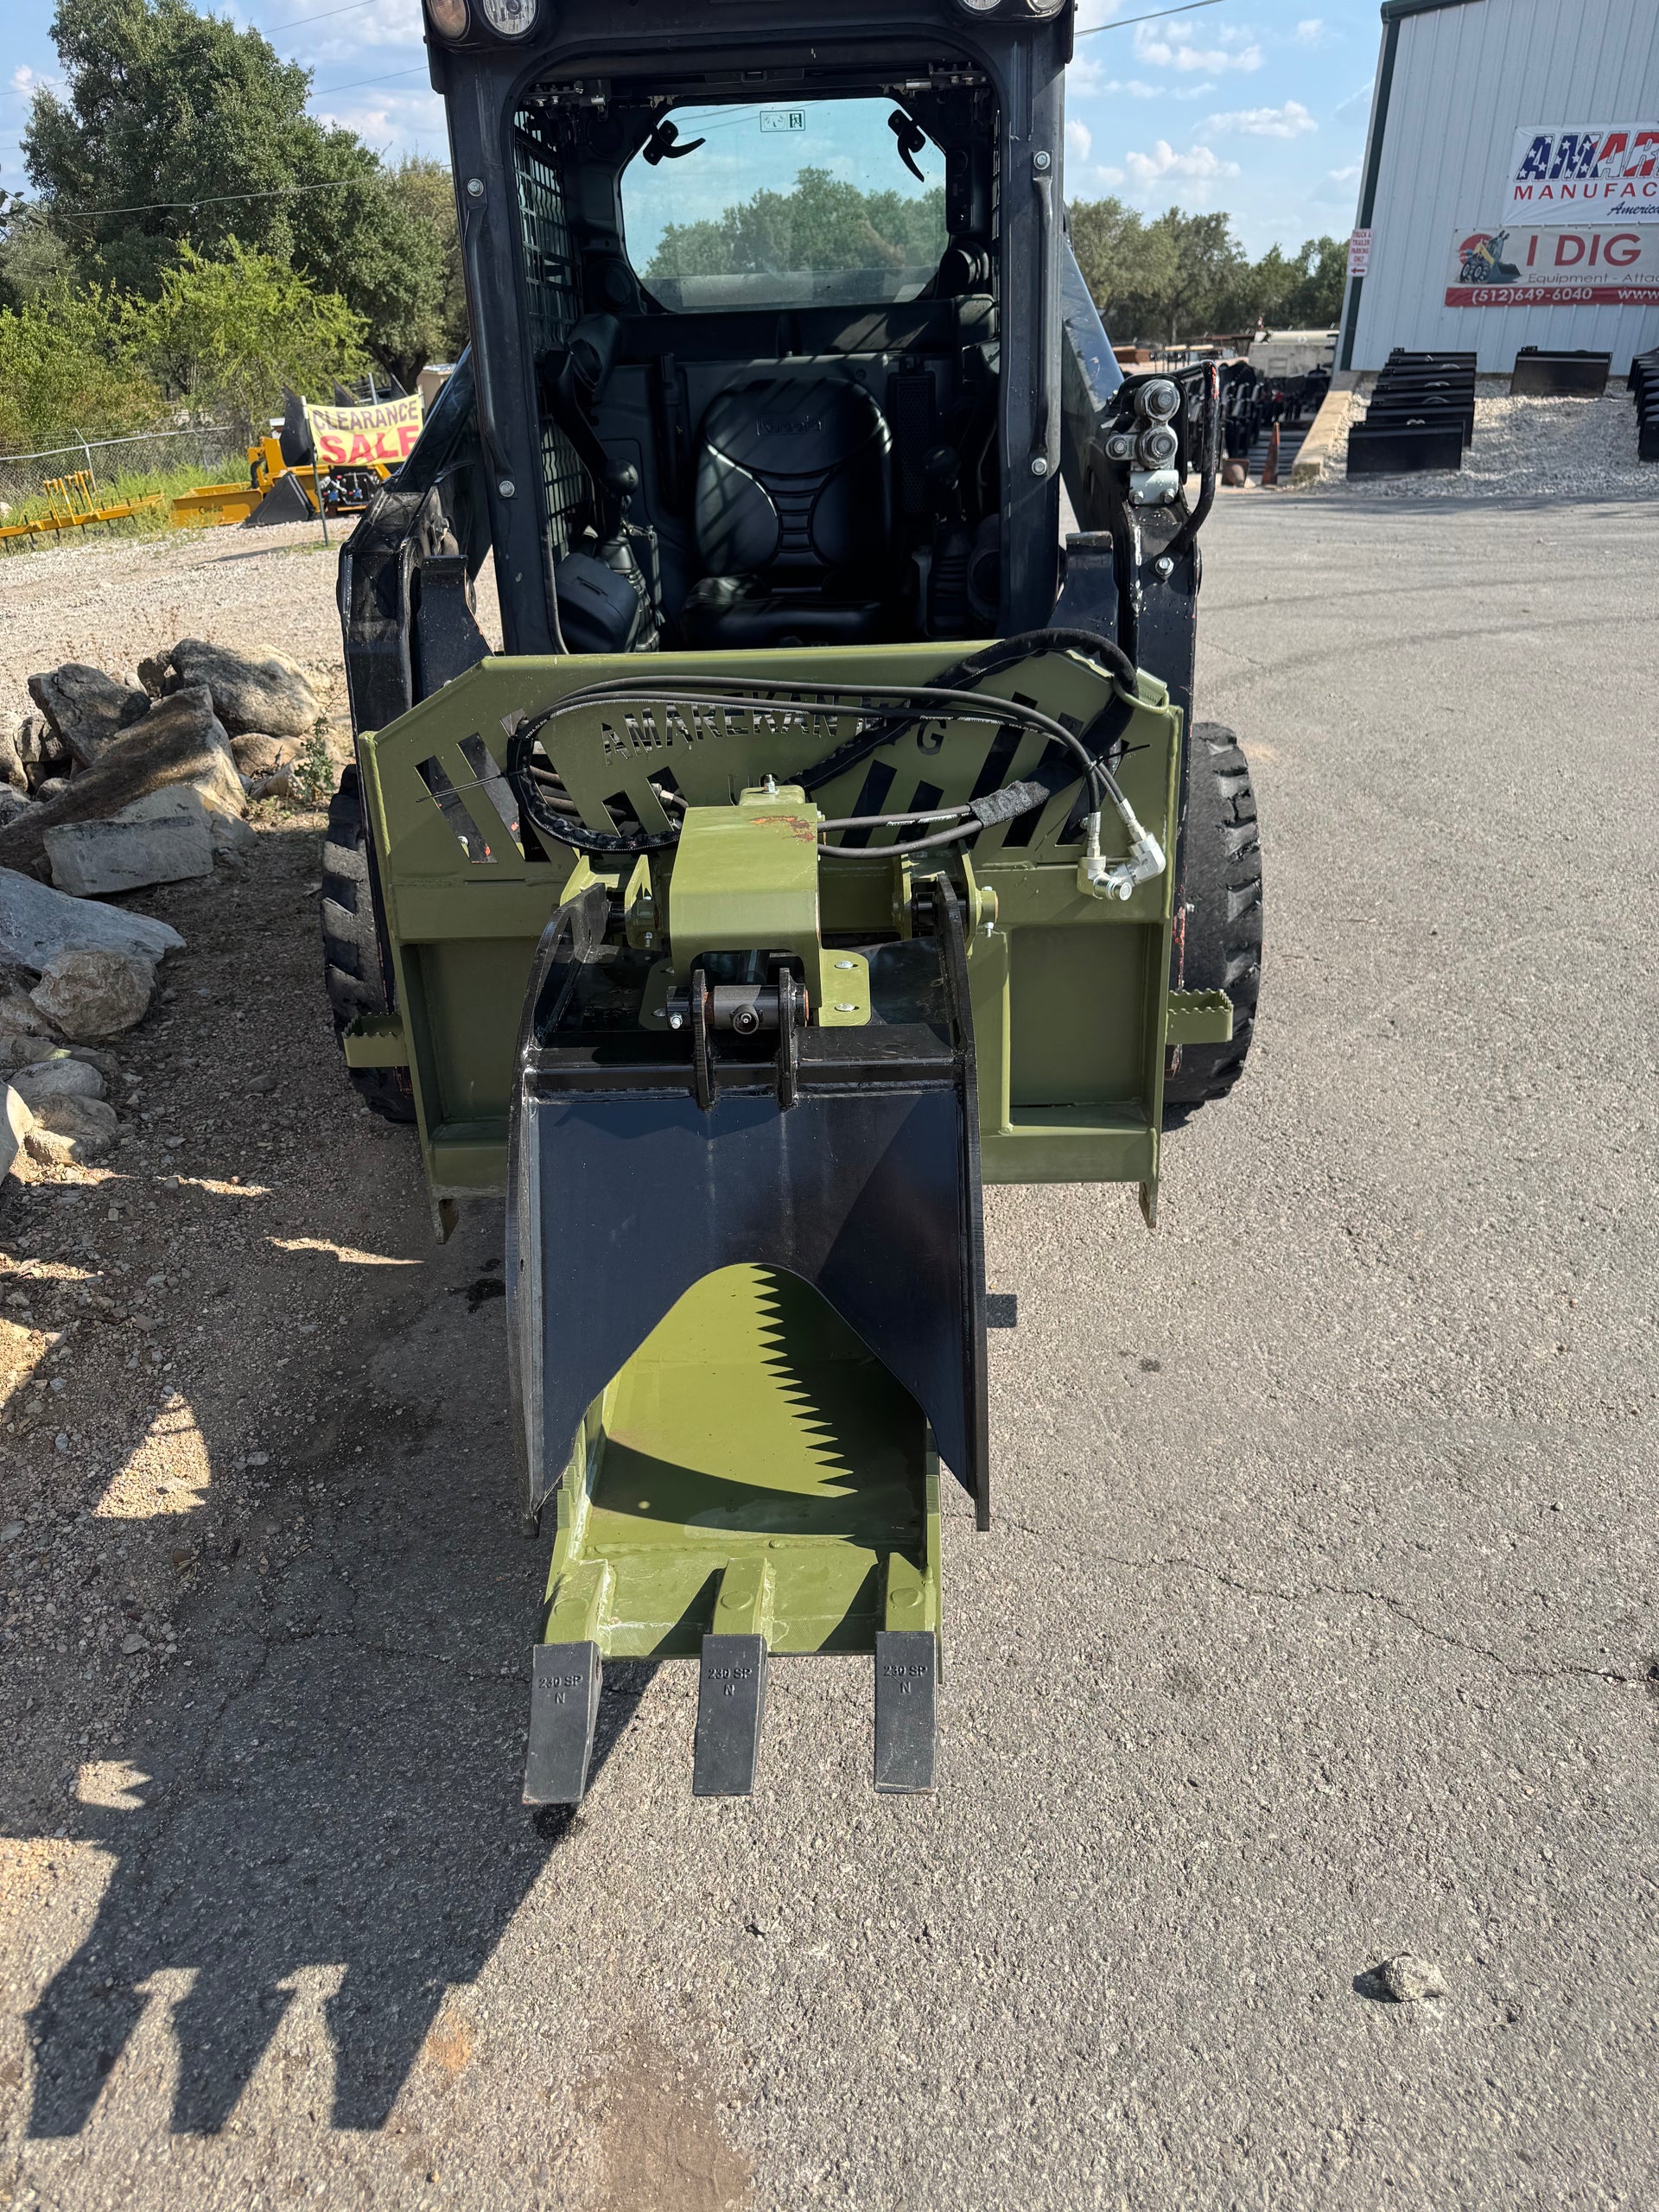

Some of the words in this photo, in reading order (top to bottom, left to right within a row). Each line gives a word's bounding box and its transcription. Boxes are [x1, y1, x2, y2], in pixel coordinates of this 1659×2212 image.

[1514, 181, 1659, 200] MANUFAC
[1526, 234, 1539, 267] I
[1554, 233, 1642, 267] DIG
[1528, 272, 1608, 284] Equipment
[1471, 288, 1592, 304] (512)649-6040
[312, 399, 419, 430] CLEARANCE
[320, 424, 419, 465] SALE
[708, 1667, 731, 1680] 230
[734, 1666, 753, 1679] SP
[883, 1664, 906, 1677] 230
[909, 1665, 928, 1677] SP
[539, 1676, 562, 1688] 230
[564, 1675, 583, 1687] SP
[900, 1681, 911, 1694] N
[723, 1684, 734, 1696] N
[555, 1692, 566, 1705] N
